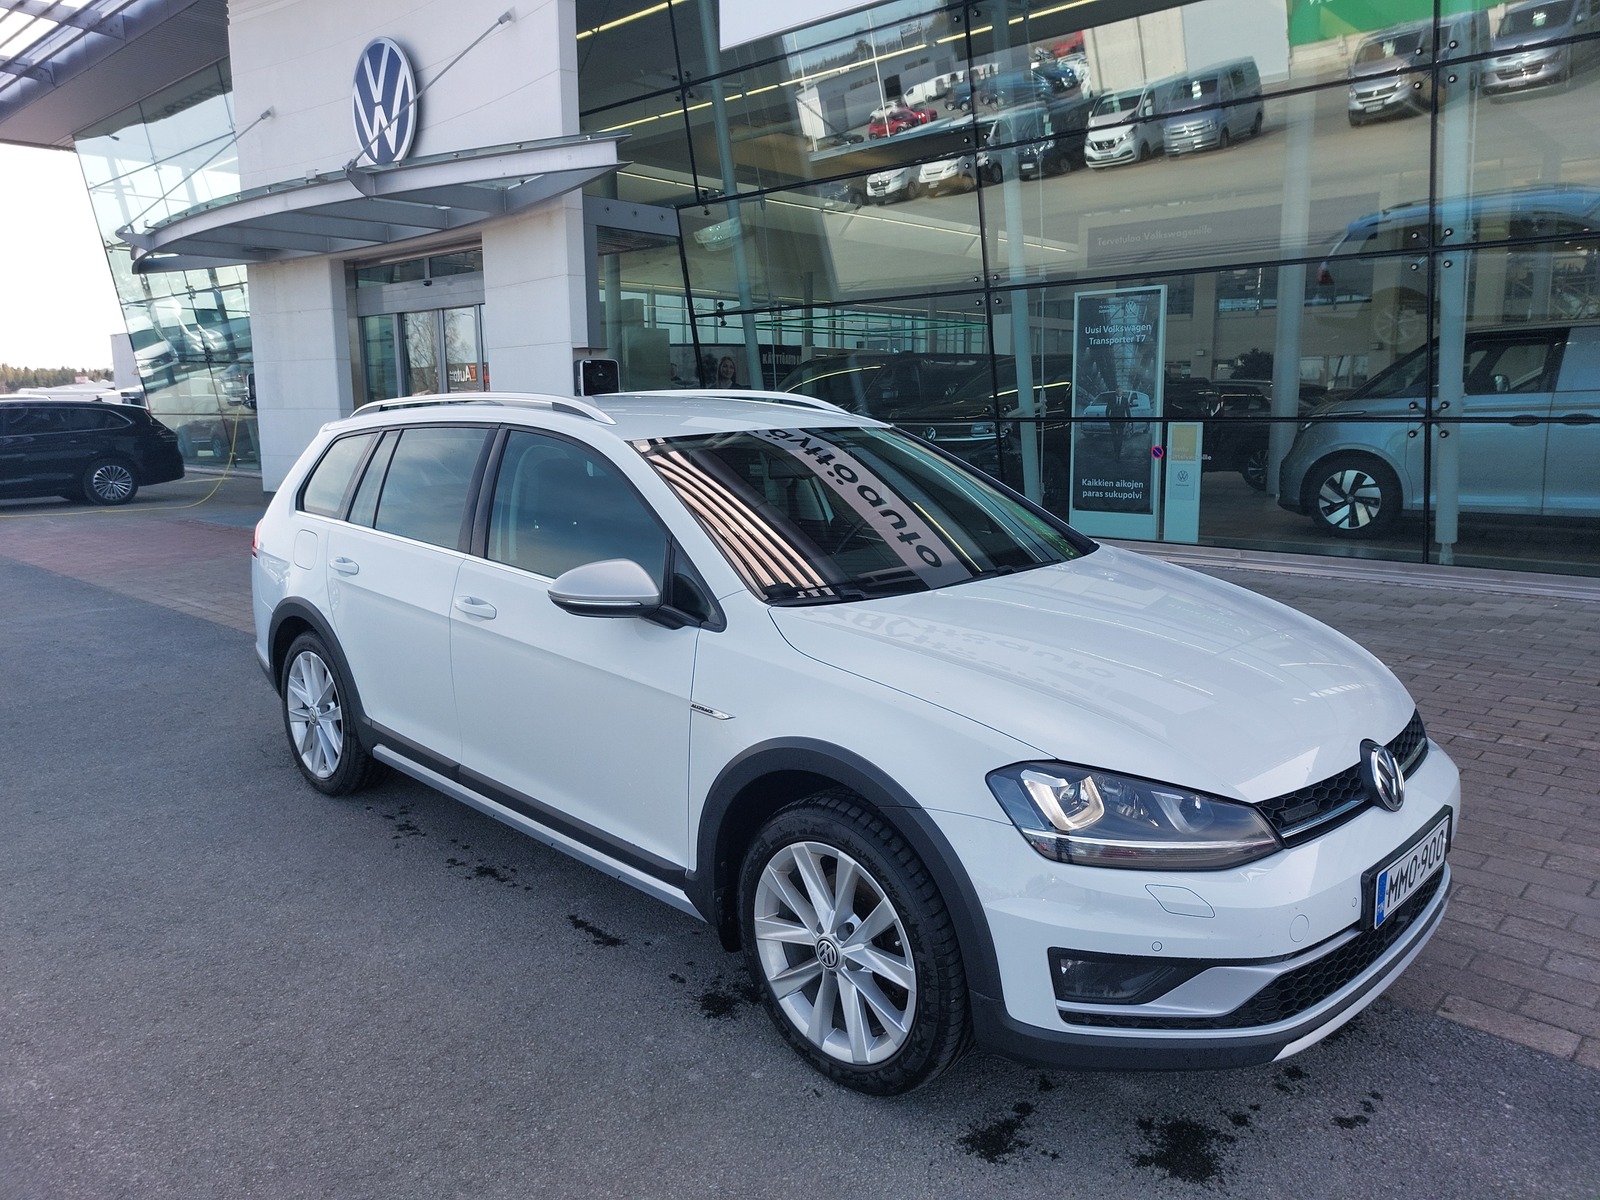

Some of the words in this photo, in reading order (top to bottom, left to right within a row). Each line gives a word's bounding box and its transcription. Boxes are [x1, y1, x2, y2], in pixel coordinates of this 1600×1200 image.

[353, 37, 417, 165] VW
[1097, 234, 1141, 247] Tervetuloa
[1143, 224, 1213, 241] Volkswagenille
[1085, 325, 1102, 335] Uusi
[1103, 324, 1152, 334] Volkswagen
[1089, 336, 1135, 346] Transporter
[1136, 334, 1147, 343] T7
[1081, 478, 1114, 488] Kaikkien
[1115, 479, 1144, 490] aikojen
[1082, 490, 1104, 499] paras
[1104, 490, 1143, 500] sukupolvi
[1386, 829, 1445, 909] MMO-900
